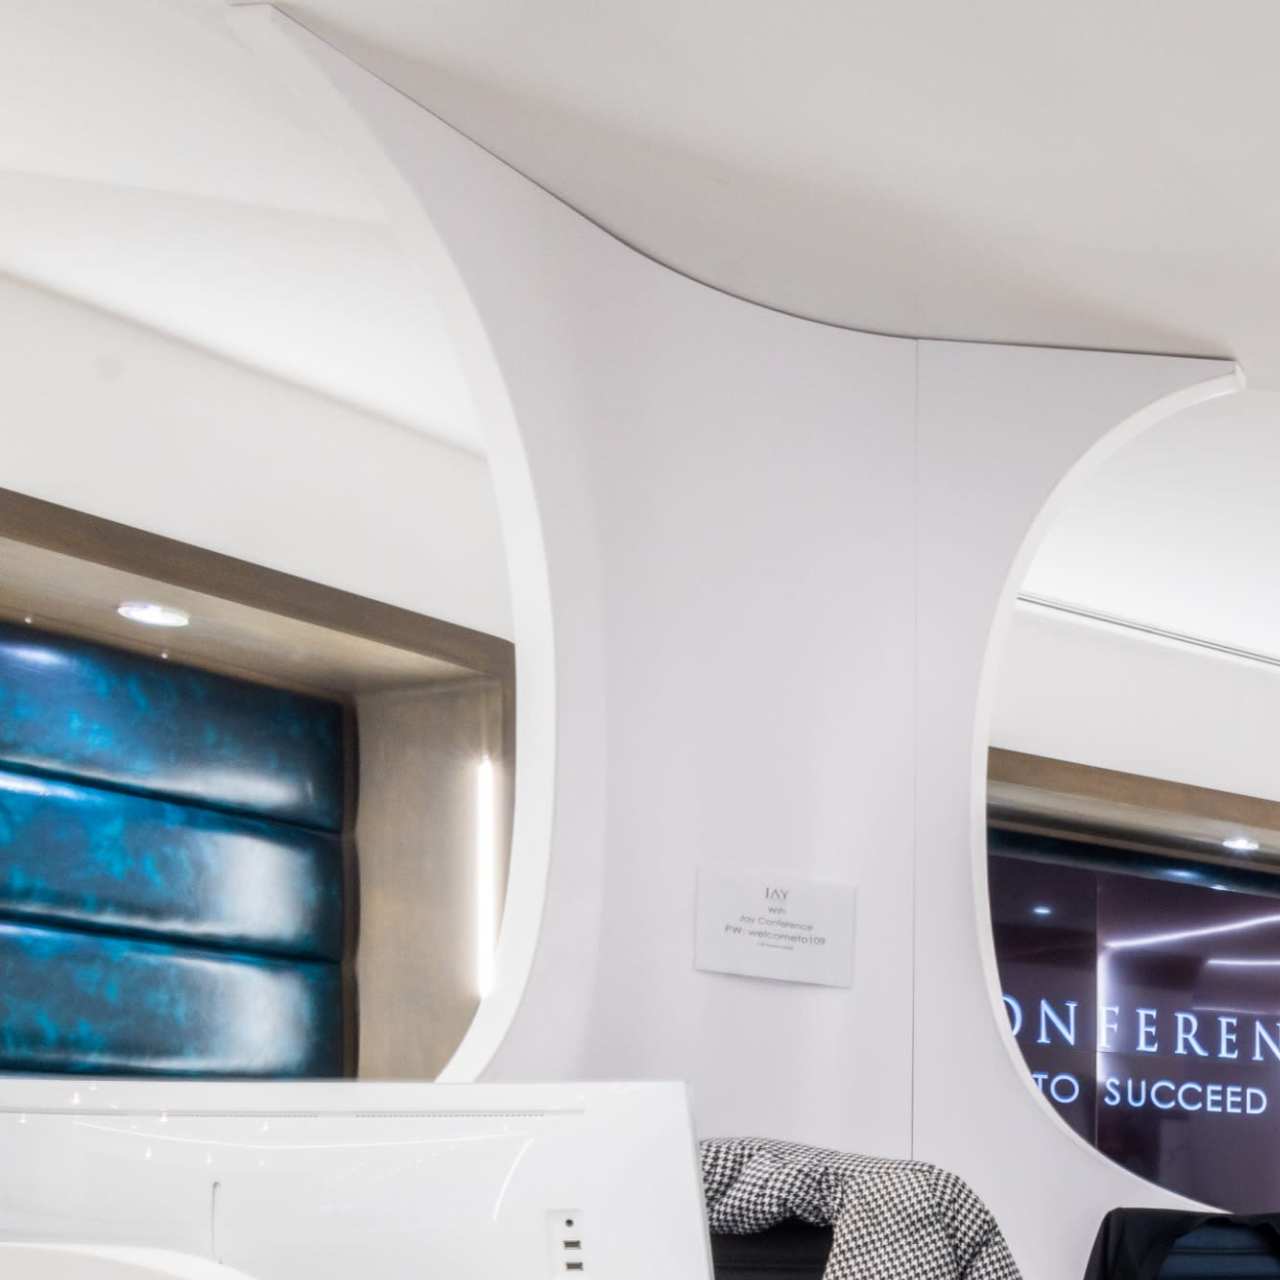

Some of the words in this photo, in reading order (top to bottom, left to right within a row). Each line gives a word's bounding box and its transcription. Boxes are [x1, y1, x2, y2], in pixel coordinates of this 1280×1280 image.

[766, 887, 789, 900] JAY
[757, 916, 815, 932] Conference
[1032, 1073, 1080, 1104] TO
[1104, 1077, 1268, 1115] SUCCEED
